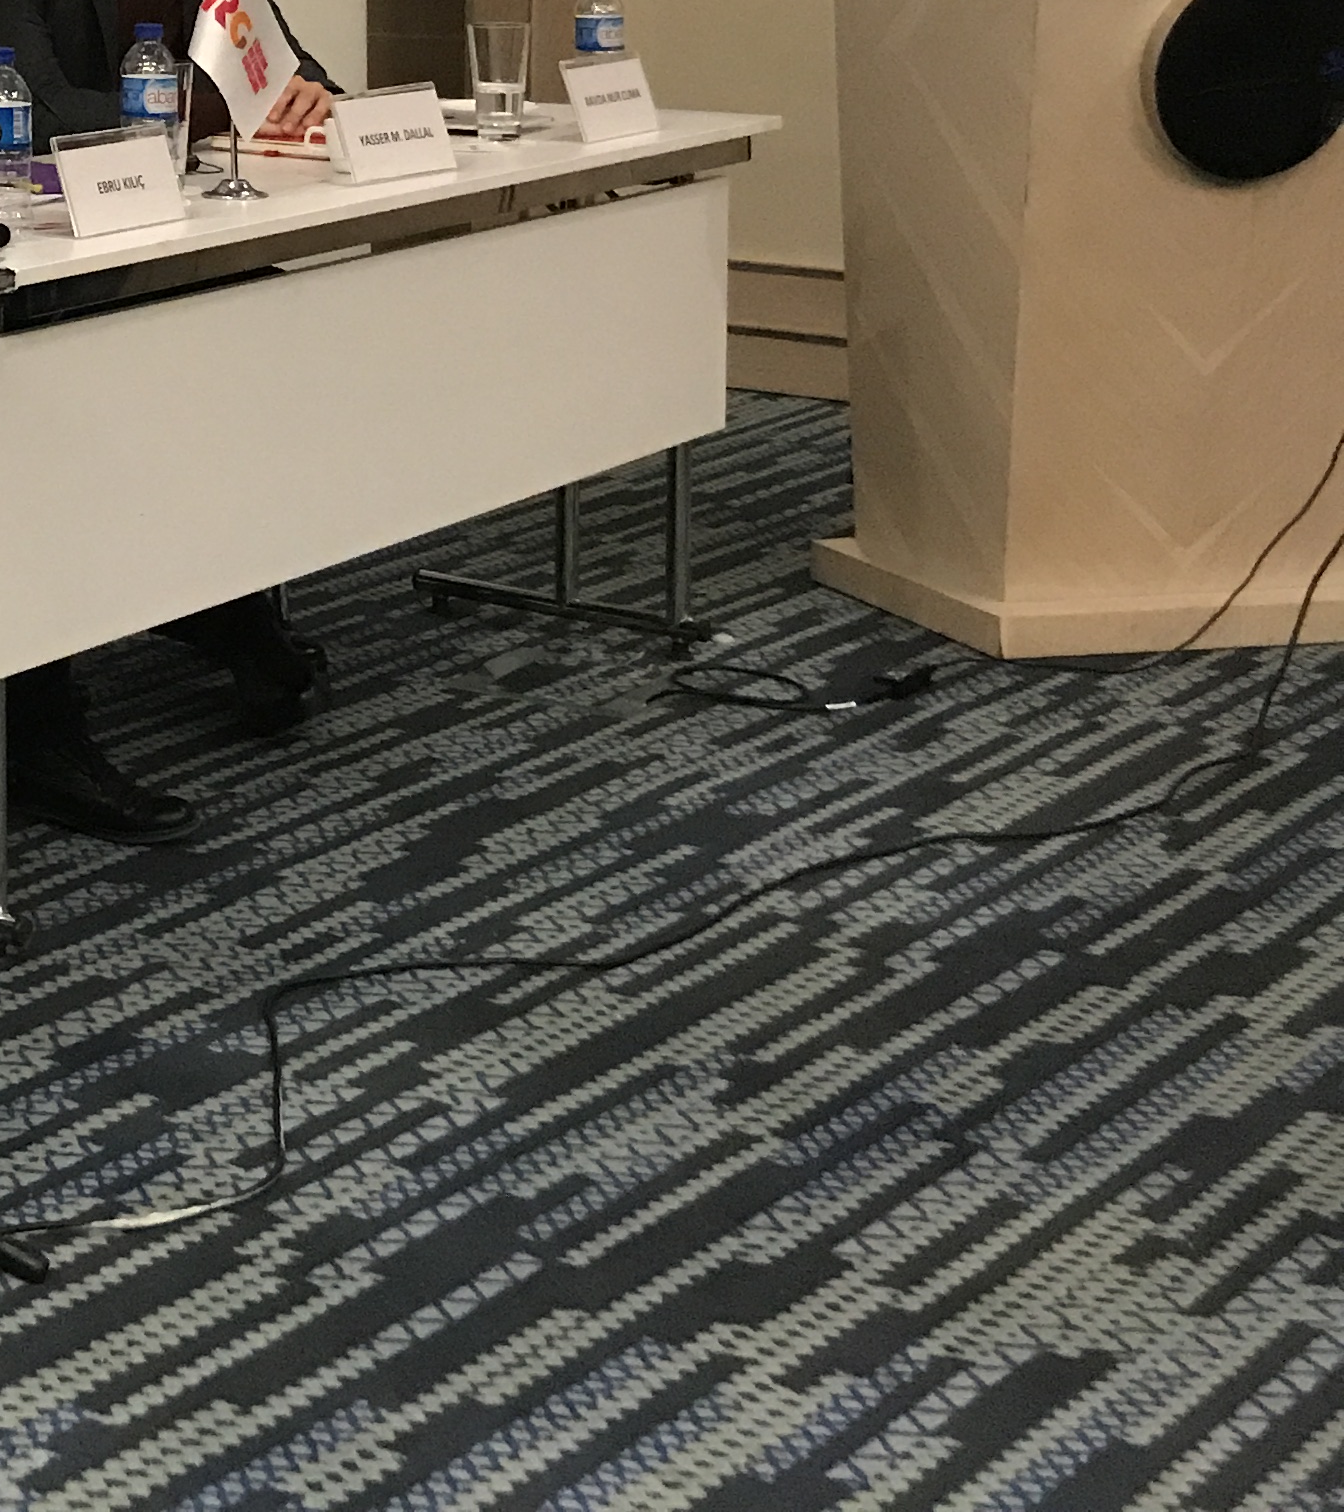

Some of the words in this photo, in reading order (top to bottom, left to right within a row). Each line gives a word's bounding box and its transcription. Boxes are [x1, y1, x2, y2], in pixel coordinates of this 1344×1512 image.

[358, 132, 391, 147] YASSER
[403, 127, 435, 141] DALLAL
[97, 178, 122, 194] EBRU
[123, 175, 146, 190] KILIÇ
